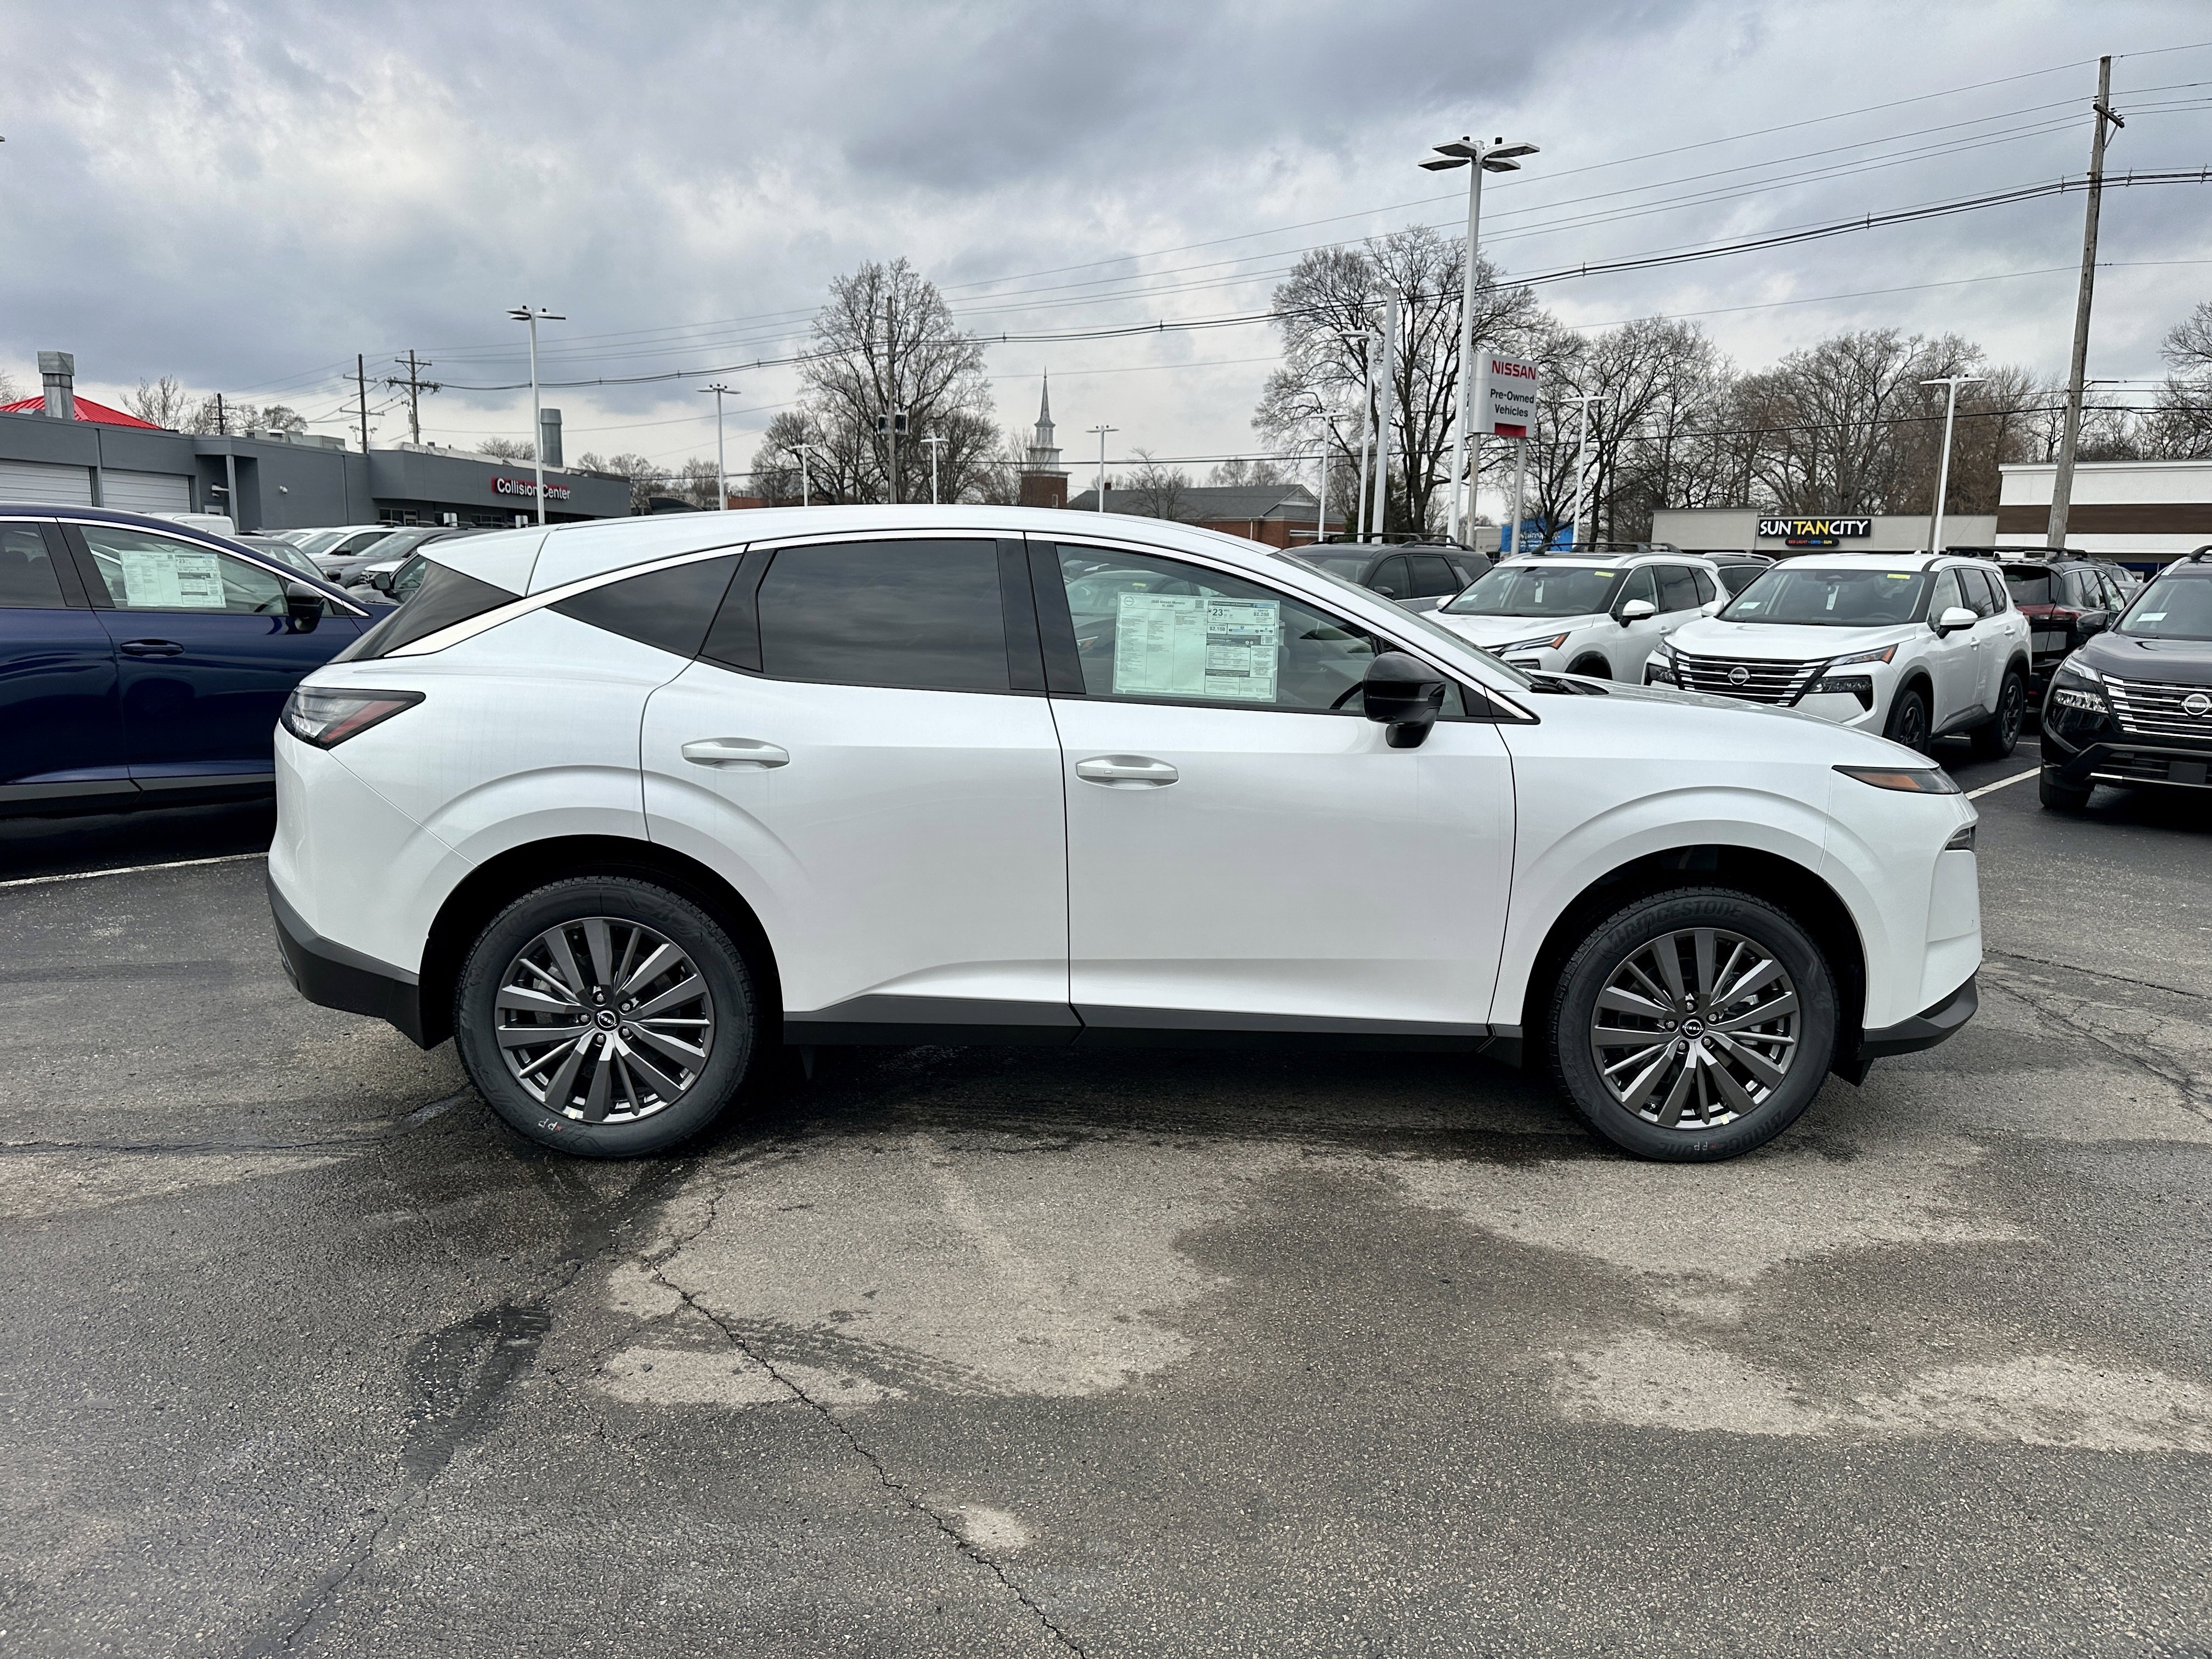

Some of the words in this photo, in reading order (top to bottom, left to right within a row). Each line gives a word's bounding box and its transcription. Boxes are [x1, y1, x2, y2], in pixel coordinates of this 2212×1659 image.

[1492, 360, 1536, 380] NISSAN
[1490, 388, 1534, 403] Pre-Owned
[1494, 404, 1528, 417] Vehicles
[497, 478, 538, 496] Collision
[543, 484, 571, 500] Center
